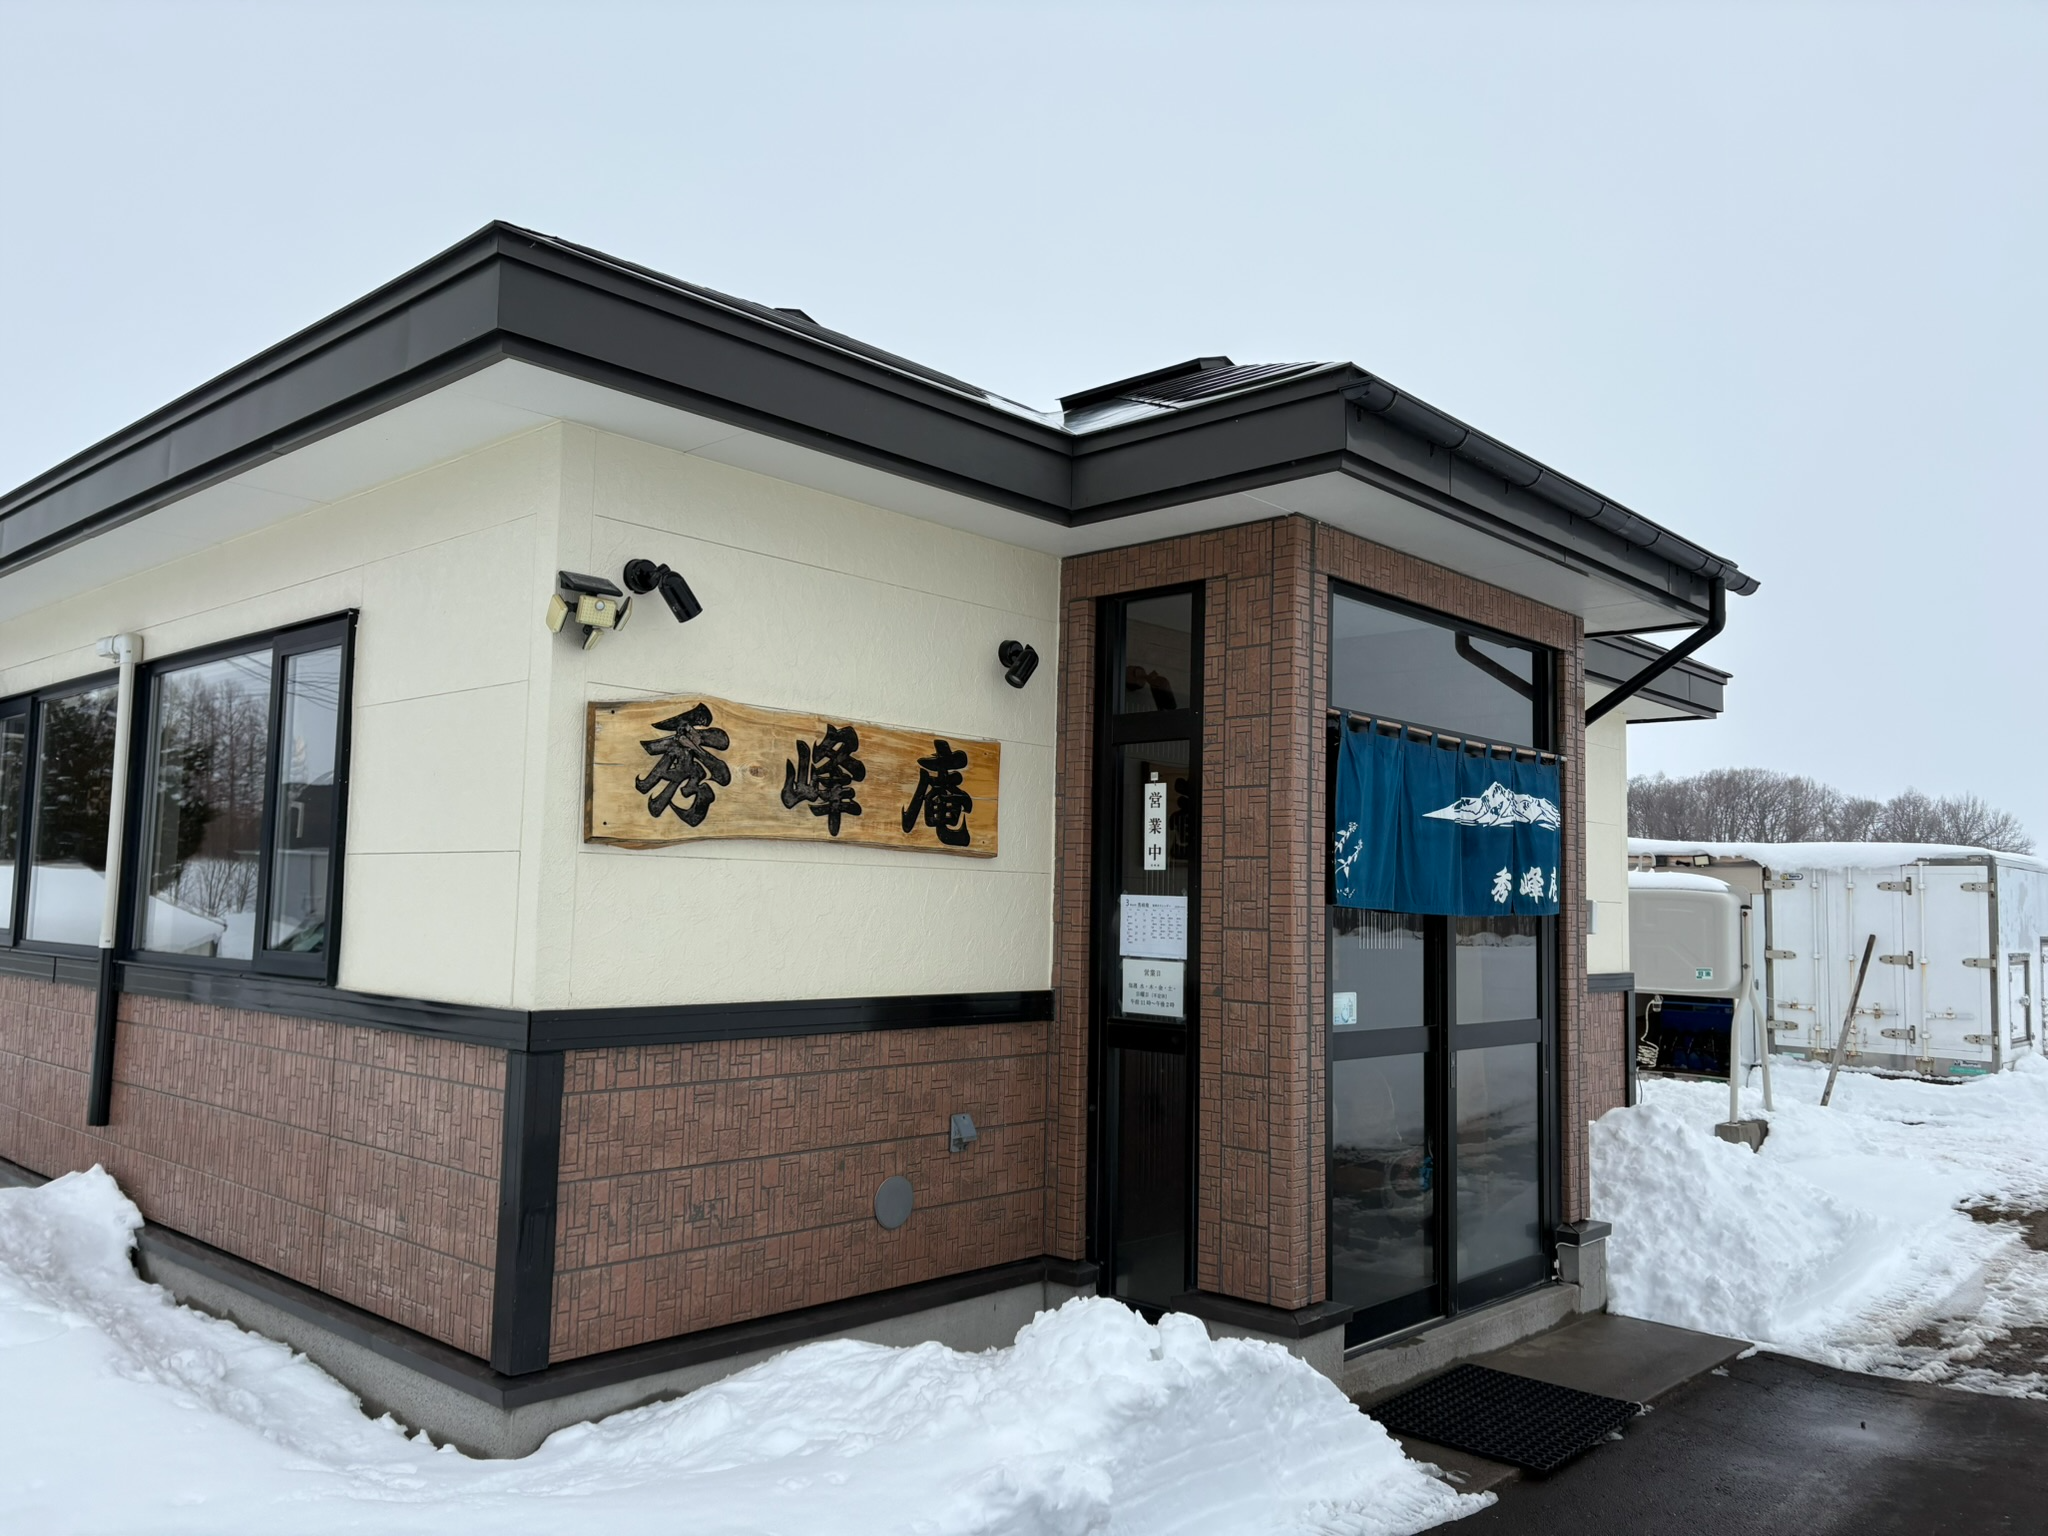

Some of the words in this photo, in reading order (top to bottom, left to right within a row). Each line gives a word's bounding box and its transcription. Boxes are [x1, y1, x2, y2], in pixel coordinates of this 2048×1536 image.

[634, 702, 973, 847] 秀峰庵
[1148, 791, 1163, 861] 営業中
[1144, 968, 1161, 977] 営業日
